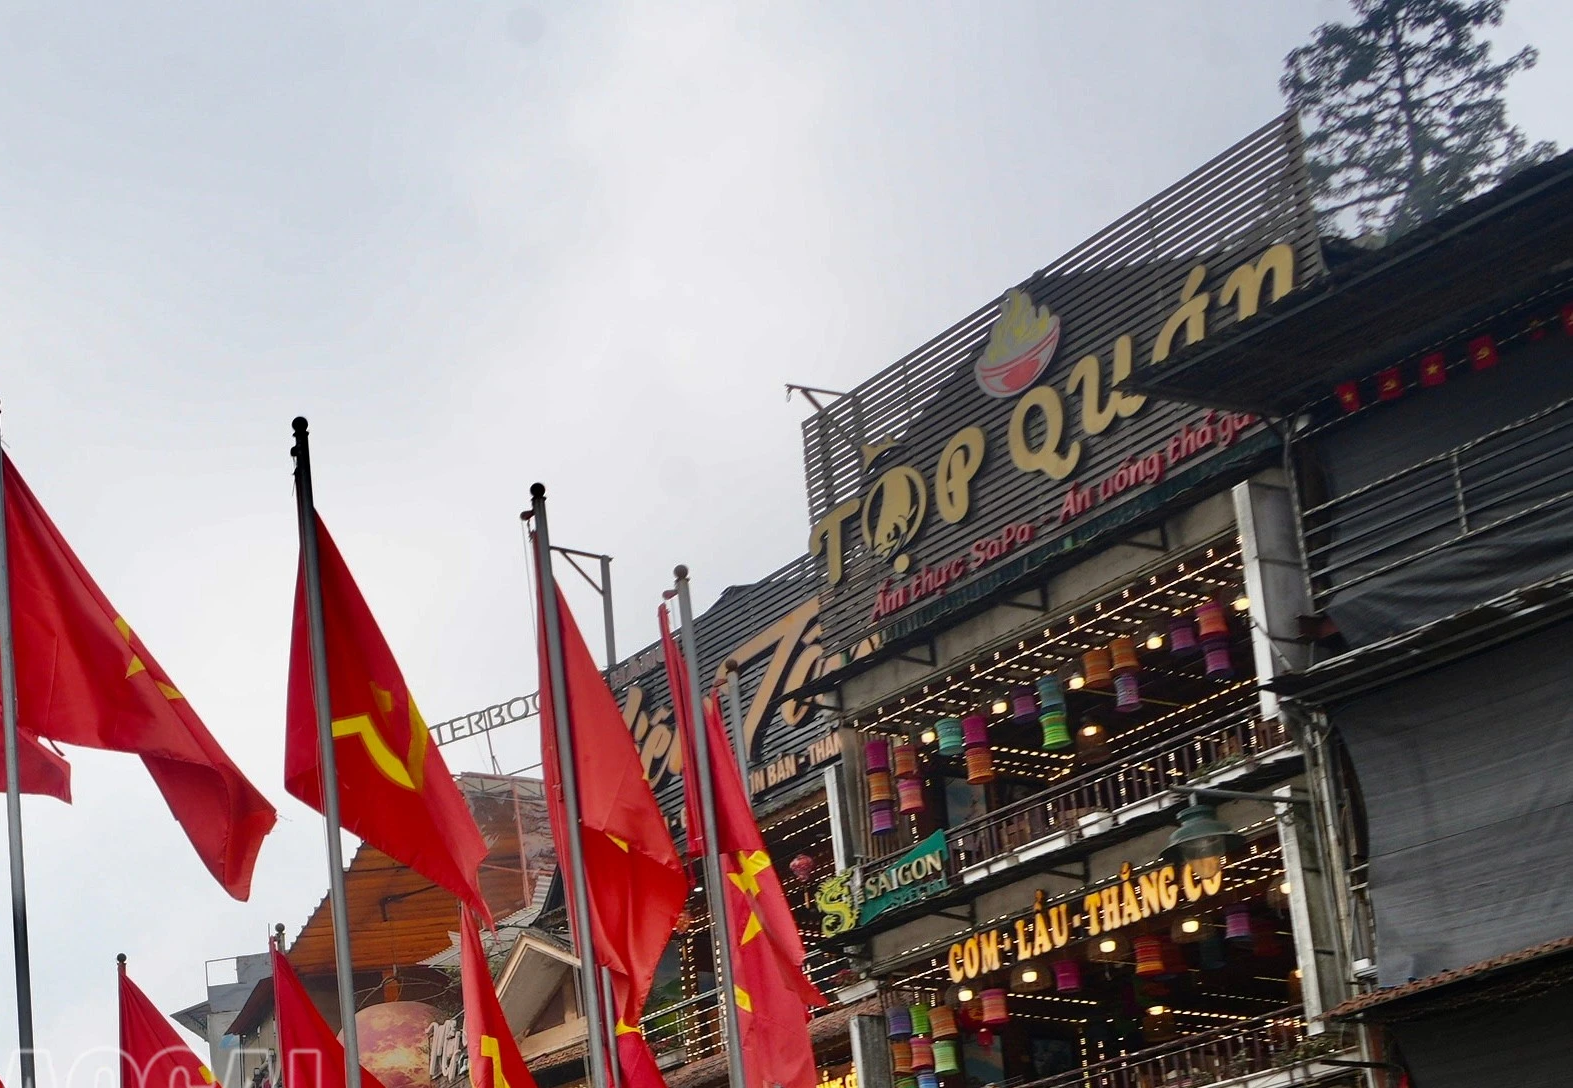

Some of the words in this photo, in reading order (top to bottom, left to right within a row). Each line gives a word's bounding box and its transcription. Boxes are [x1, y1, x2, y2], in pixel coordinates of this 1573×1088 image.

[1007, 243, 1295, 480] QUÁN
[965, 520, 1035, 575] SaPa
[864, 849, 943, 900] SAIGON
[948, 930, 1001, 983] CƠM
